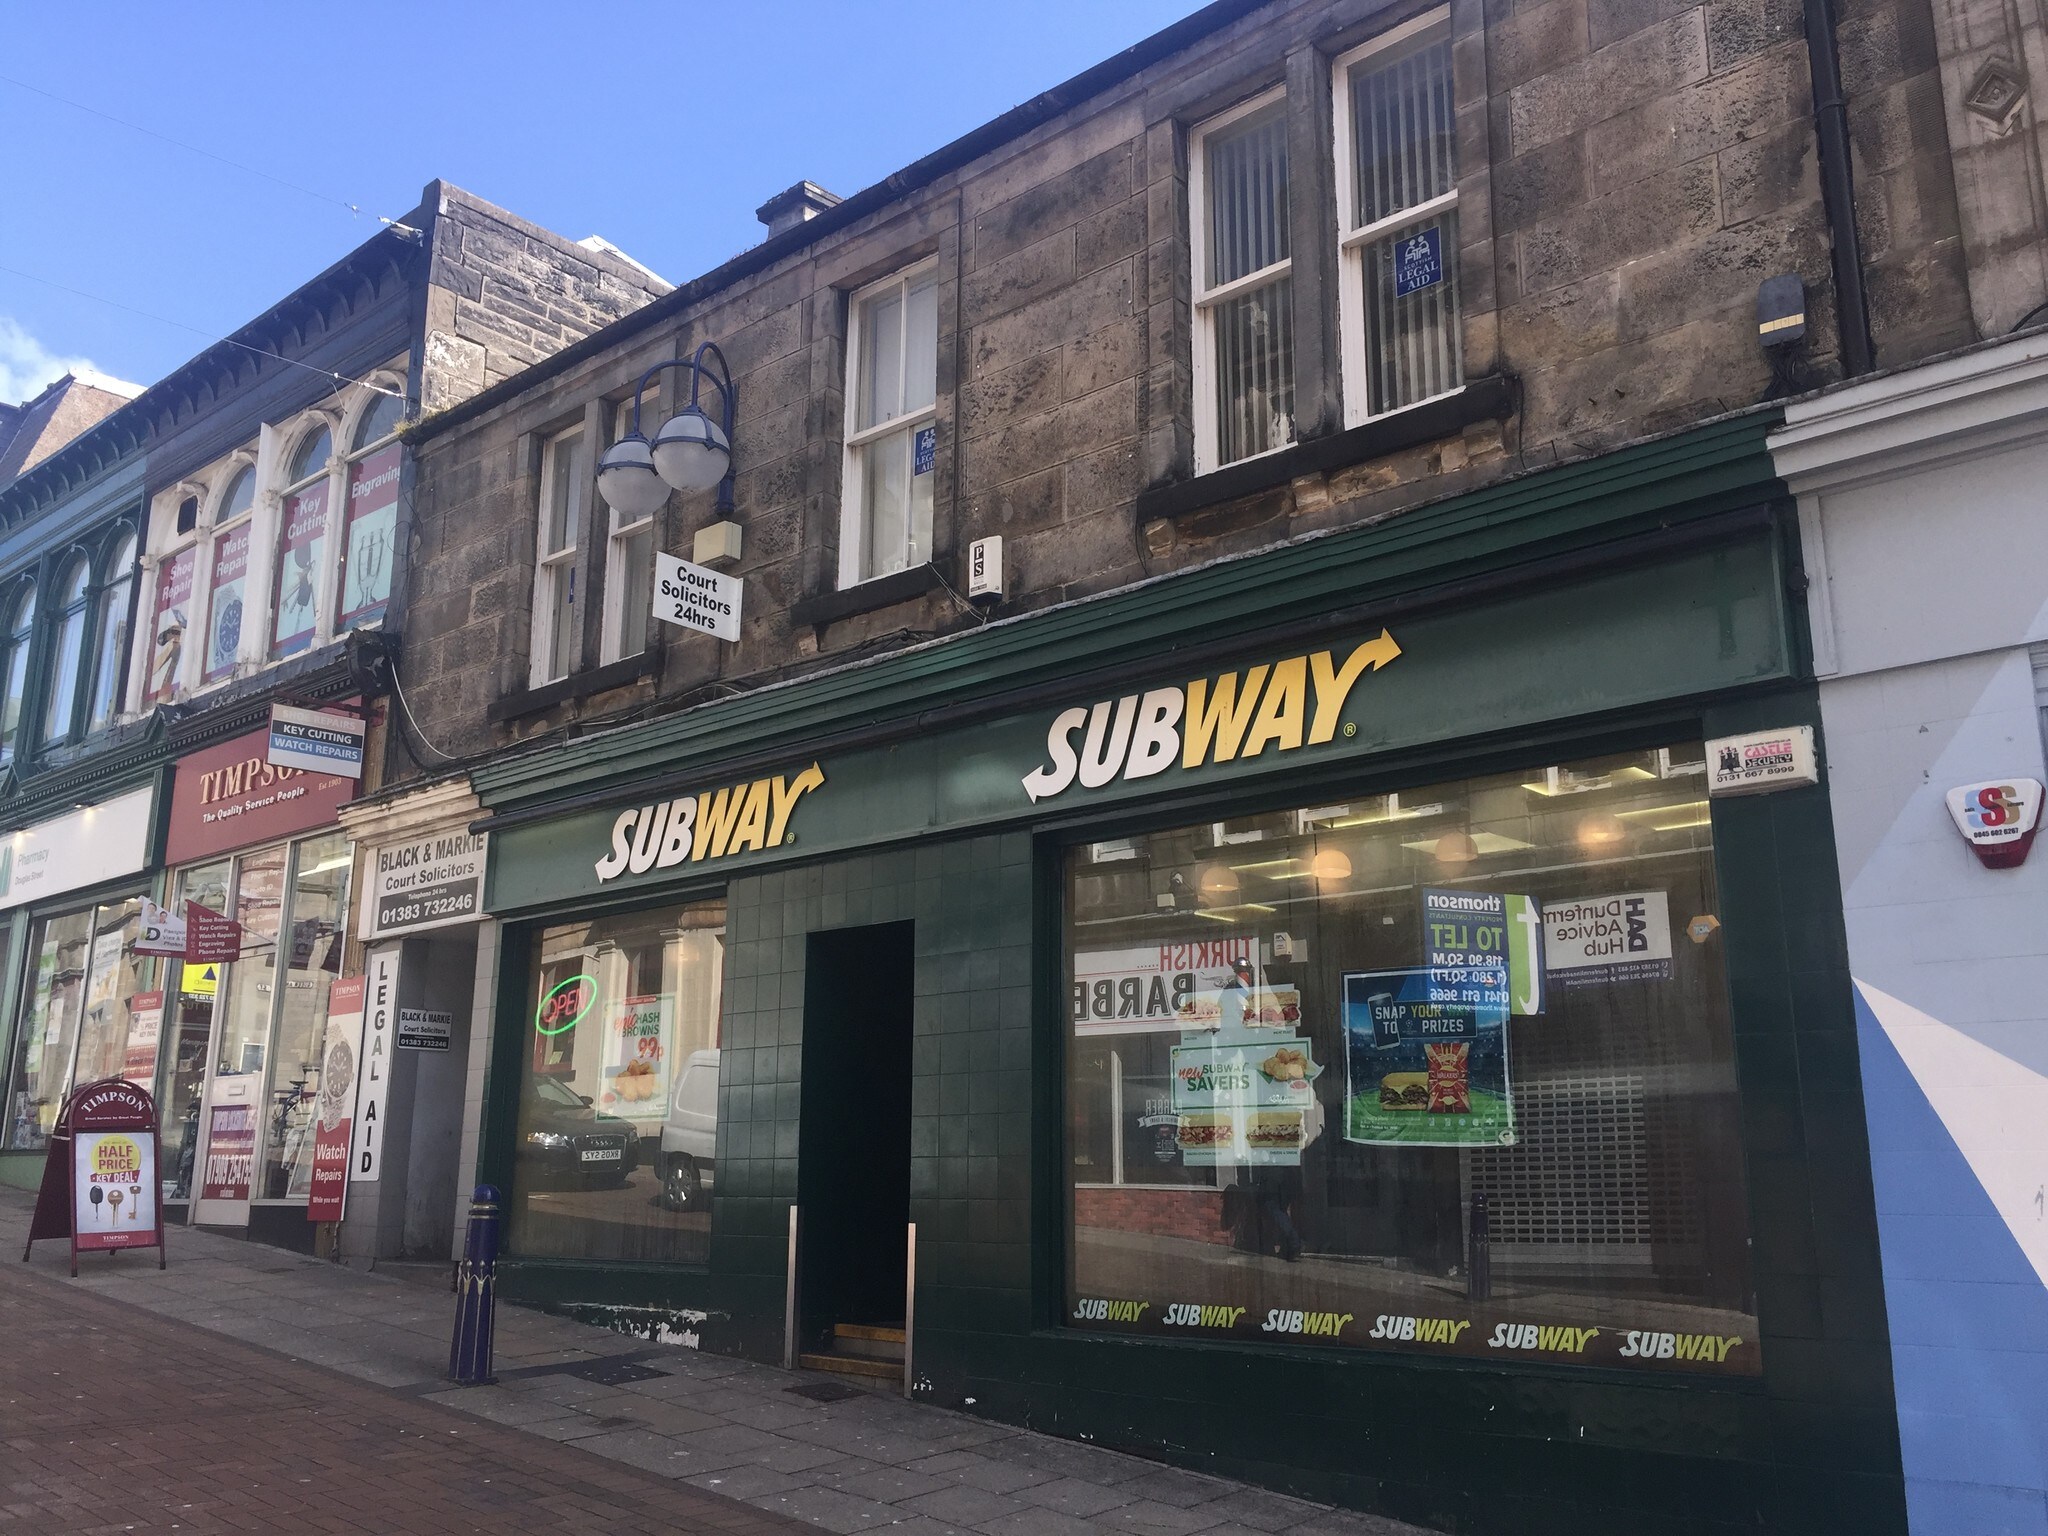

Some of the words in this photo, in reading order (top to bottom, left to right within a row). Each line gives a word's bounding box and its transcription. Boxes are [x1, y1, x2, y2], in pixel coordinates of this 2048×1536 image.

[1399, 261, 1438, 283] LEGAL
[1408, 274, 1430, 290] AID
[351, 466, 401, 499] Engraving
[300, 497, 321, 517] Key
[287, 513, 327, 540] Cutting
[170, 560, 194, 581] Shoe
[677, 566, 718, 593] Court
[661, 580, 731, 615] Solicitors
[674, 603, 716, 629] 24hrs
[283, 709, 310, 722] SHOE
[314, 713, 357, 731] REPAIRS
[1022, 627, 1402, 804] SUBWAY
[283, 724, 305, 736] KEY
[308, 729, 352, 744] CUTTING
[274, 737, 312, 752] WATCH
[315, 744, 358, 760] REPAIRS
[1744, 742, 1792, 758] CASTLE
[1747, 754, 1792, 767] SECURITY
[318, 782, 328, 791] Est
[327, 777, 342, 788] 1903
[1717, 774, 1740, 783] 0131
[1745, 770, 1763, 778] 667
[1767, 766, 1794, 775] 8999
[202, 812, 216, 823] The
[217, 804, 243, 821] Quality
[245, 795, 275, 811] Service
[276, 787, 305, 803] People
[595, 761, 825, 884] SUBWAY
[18, 848, 49, 867] Pharmacy
[380, 845, 420, 873] BLACK
[422, 843, 431, 863] &
[435, 831, 484, 860] MARKIE
[386, 872, 416, 890] Court
[419, 862, 474, 883] Solicitors
[439, 887, 447, 895] hrs
[382, 904, 420, 925] 01383
[424, 893, 473, 916] 732246
[336, 985, 360, 996] TIMPSON
[543, 986, 589, 1023] OPEN
[1375, 1006, 1406, 1019] SNAP
[1411, 1004, 1441, 1018] YOUR
[370, 961, 388, 1081] LEGAL
[402, 1011, 421, 1021] BLACK
[422, 1013, 427, 1022] &
[428, 1014, 451, 1024] MARKIE
[637, 1011, 660, 1024] HASH
[1383, 1021, 1398, 1034] TO
[1422, 1019, 1464, 1033] PRIZES
[421, 1026, 446, 1034] Solicitors
[622, 1024, 660, 1038] BROWNS
[638, 1037, 663, 1061] 99p
[1178, 1067, 1203, 1079] new
[1203, 1062, 1249, 1074] SUBWAY
[1187, 1075, 1250, 1091] SAVERS
[81, 1092, 146, 1113] TIMPSON
[361, 1100, 377, 1173] AID
[98, 1145, 133, 1157] HALF
[317, 1143, 346, 1160] Watch
[98, 1159, 133, 1170] PRICE
[96, 1173, 112, 1183] KEY
[113, 1172, 135, 1182] DEAL
[315, 1168, 342, 1183] Repairs
[1073, 1298, 1150, 1322] SUBWAY
[1162, 1303, 1246, 1328] SUBWAY
[1261, 1308, 1353, 1336] SUBWAY
[1369, 1314, 1470, 1344] SUBWAY
[1487, 1322, 1600, 1353] SUBWAY
[1618, 1330, 1743, 1362] SUBWAY
